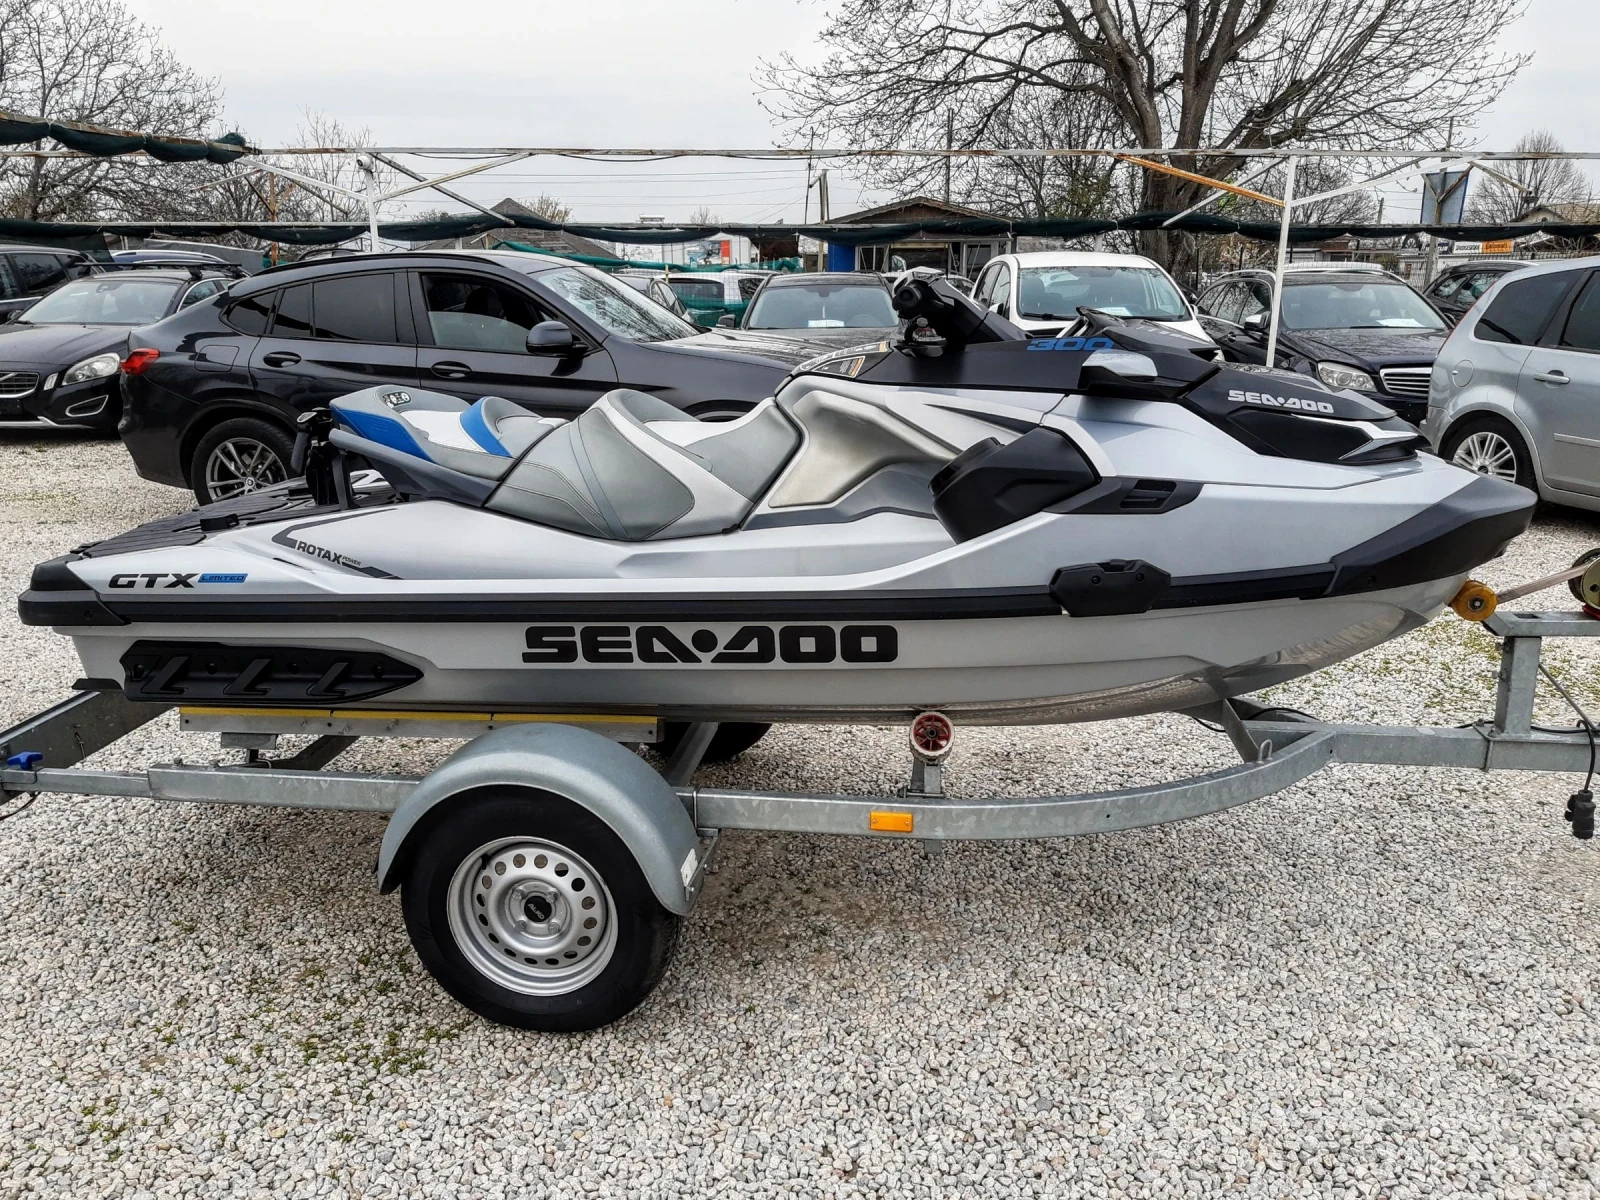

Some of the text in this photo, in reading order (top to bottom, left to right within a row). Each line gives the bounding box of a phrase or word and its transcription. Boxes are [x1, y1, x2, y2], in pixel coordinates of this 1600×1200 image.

[1027, 338, 1115, 351] 300
[297, 540, 362, 566] ROTAX POWER
[108, 573, 246, 588] GTX LIMITED
